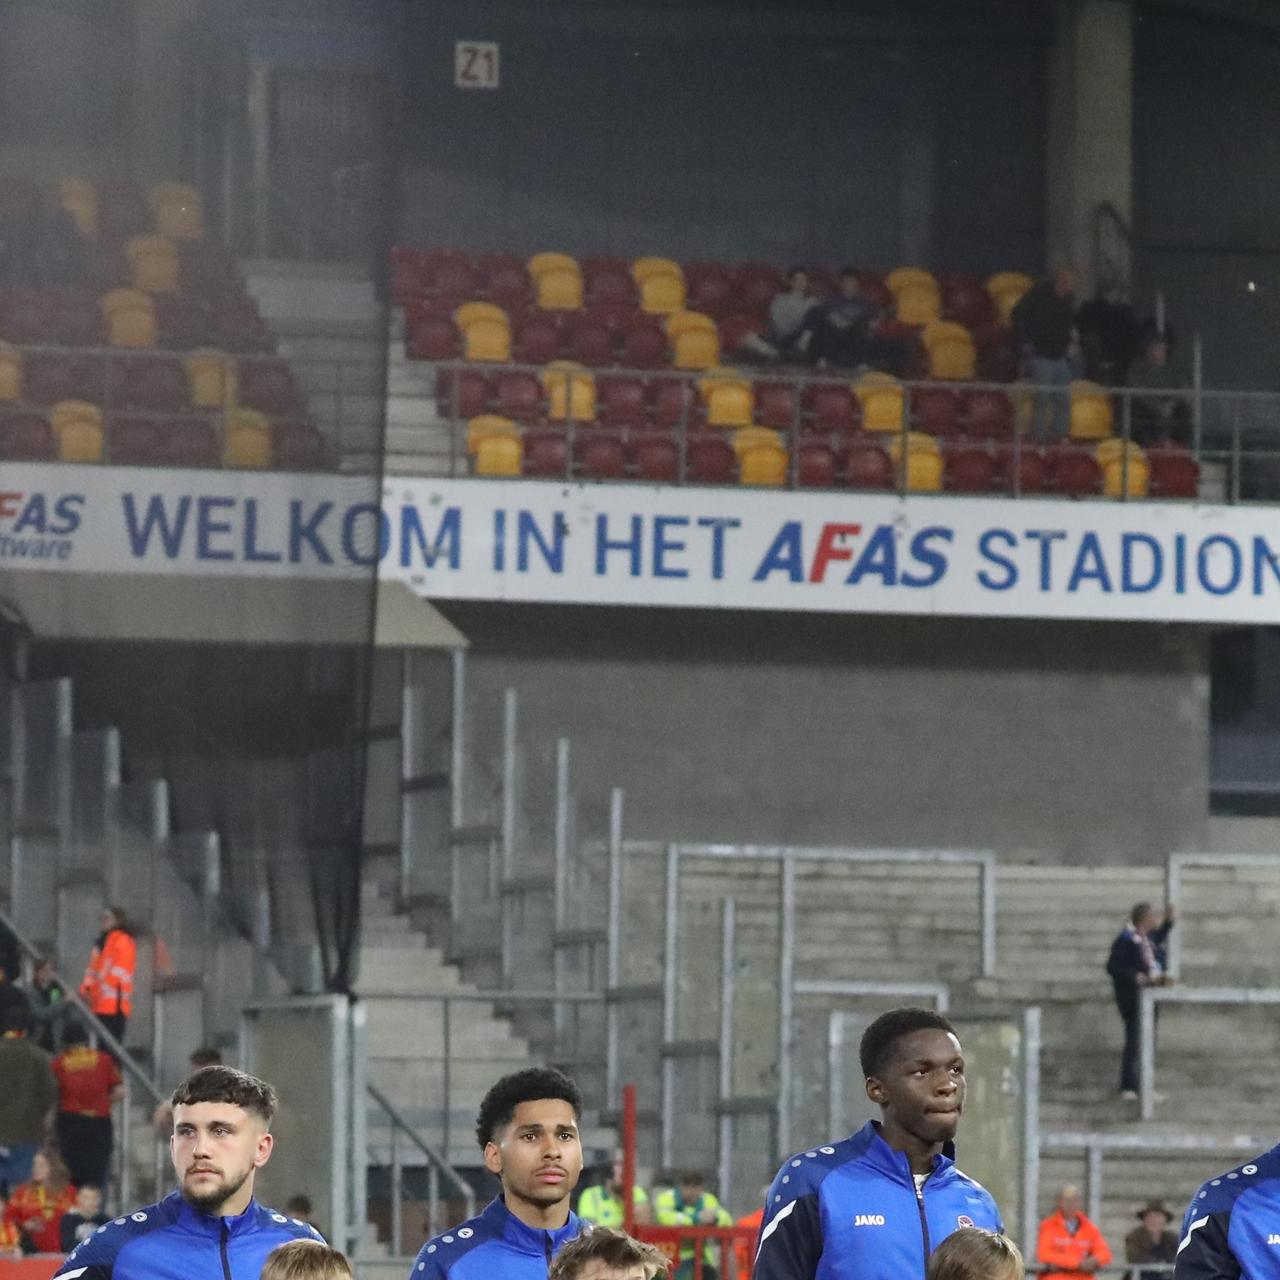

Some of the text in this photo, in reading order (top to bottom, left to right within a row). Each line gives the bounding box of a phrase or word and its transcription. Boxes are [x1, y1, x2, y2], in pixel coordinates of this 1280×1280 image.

[121, 493, 462, 571] WELKOM
[493, 510, 565, 574] IN
[595, 514, 740, 579] HET
[753, 521, 954, 588] AFAS
[855, 1215, 885, 1226] JAKO
